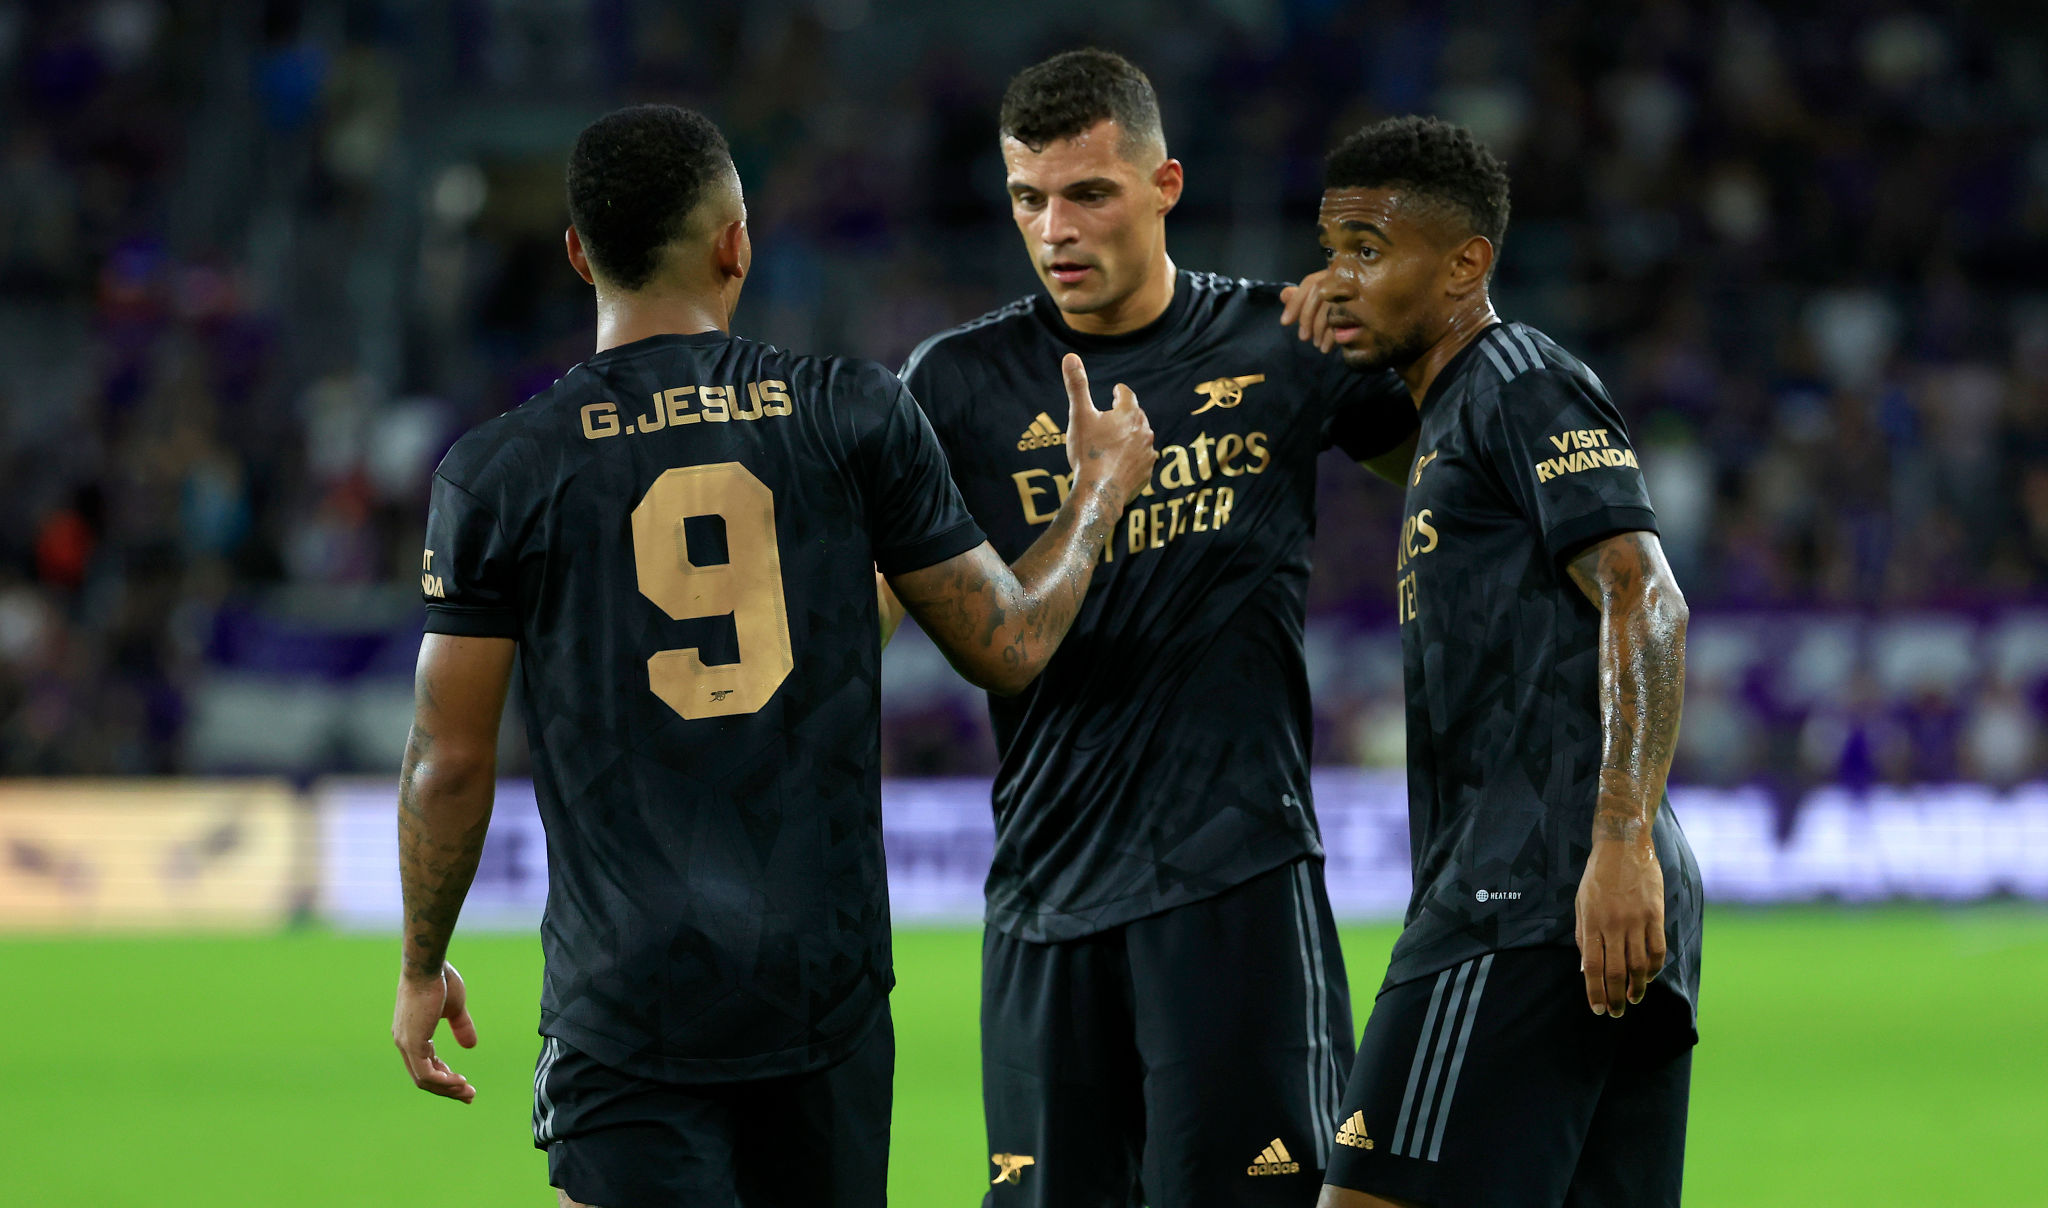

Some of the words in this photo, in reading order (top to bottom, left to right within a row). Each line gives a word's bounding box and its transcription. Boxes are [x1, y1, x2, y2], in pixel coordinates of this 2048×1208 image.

[580, 380, 793, 439] G.JESUS
[1549, 429, 1610, 453] VISIT
[1535, 448, 1640, 483] RWANDA
[631, 461, 794, 720] 9
[1335, 1131, 1374, 1150] adidas
[1247, 1162, 1300, 1176] adidas
